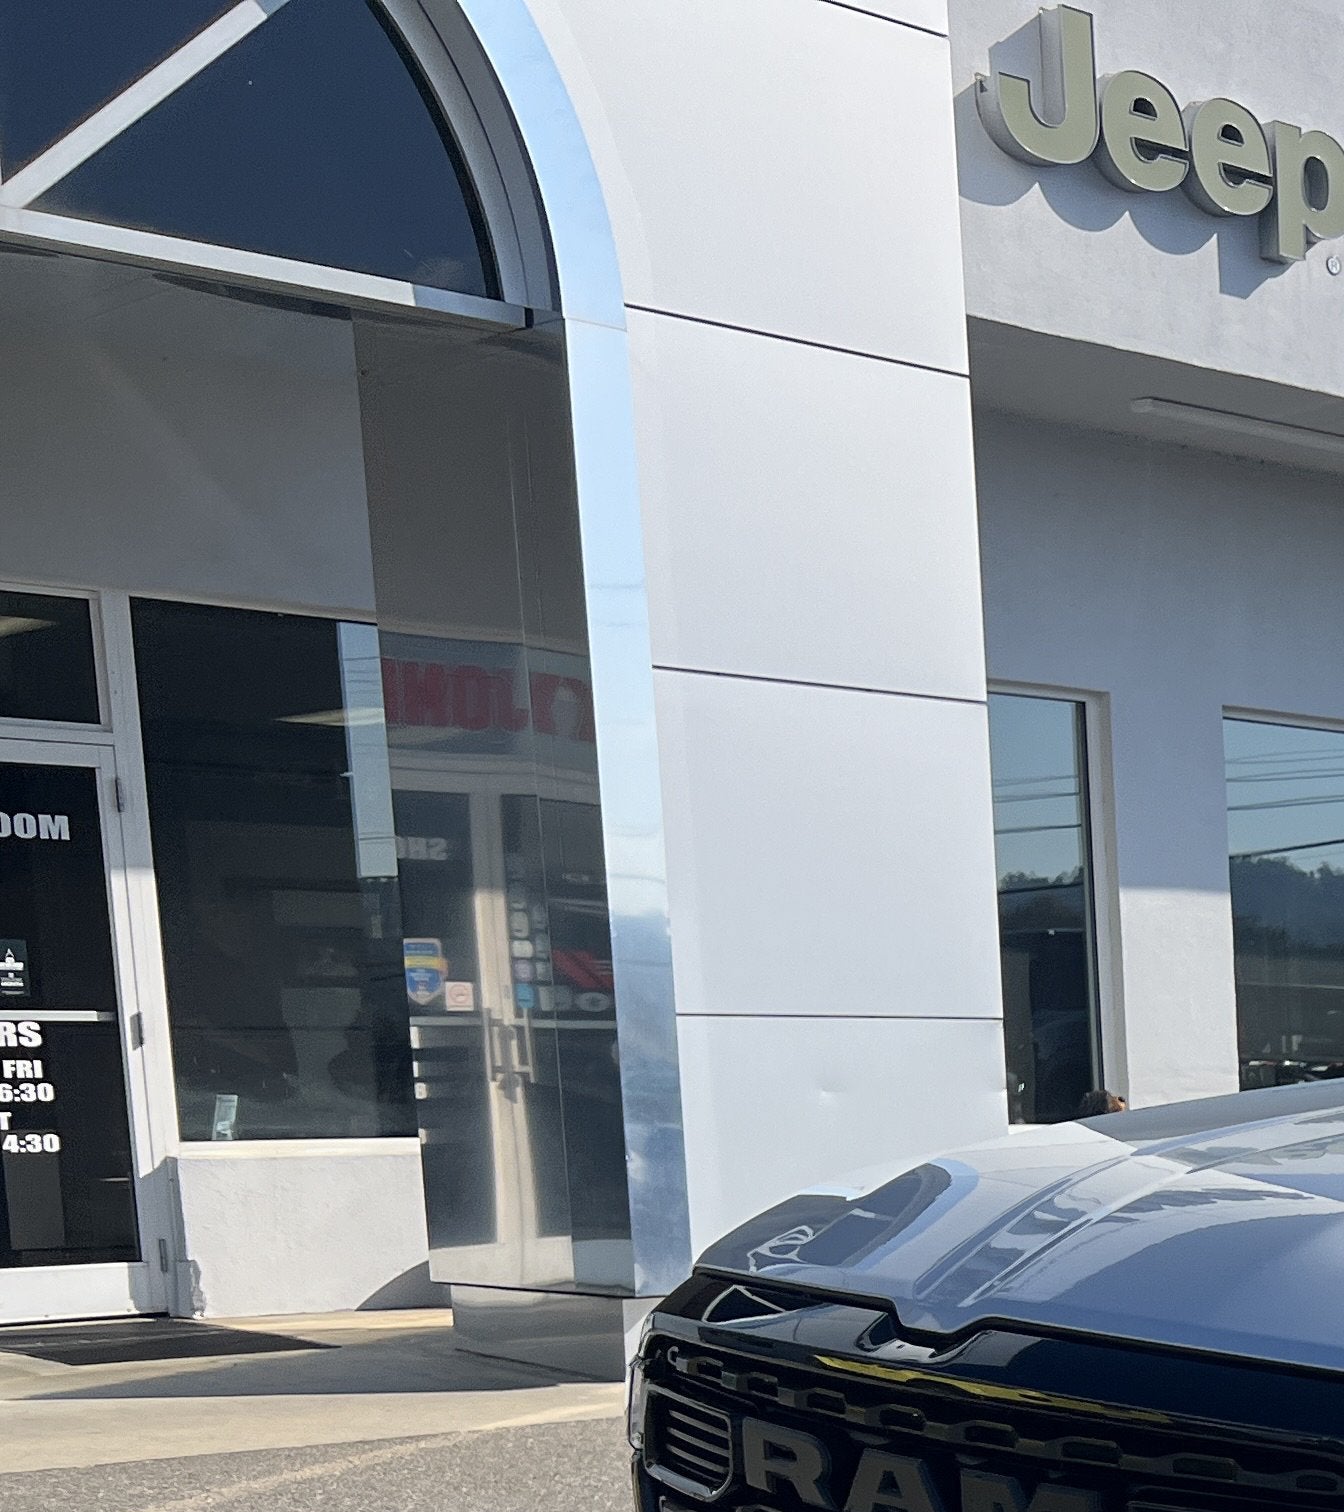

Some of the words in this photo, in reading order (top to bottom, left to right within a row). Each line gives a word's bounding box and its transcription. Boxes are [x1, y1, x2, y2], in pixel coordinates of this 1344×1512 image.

[0, 1020, 43, 1048] RS
[2, 1059, 44, 1079] FRI
[0, 1082, 56, 1103] 6:30
[0, 1111, 13, 1131] T
[1, 1133, 61, 1154] 4:30
